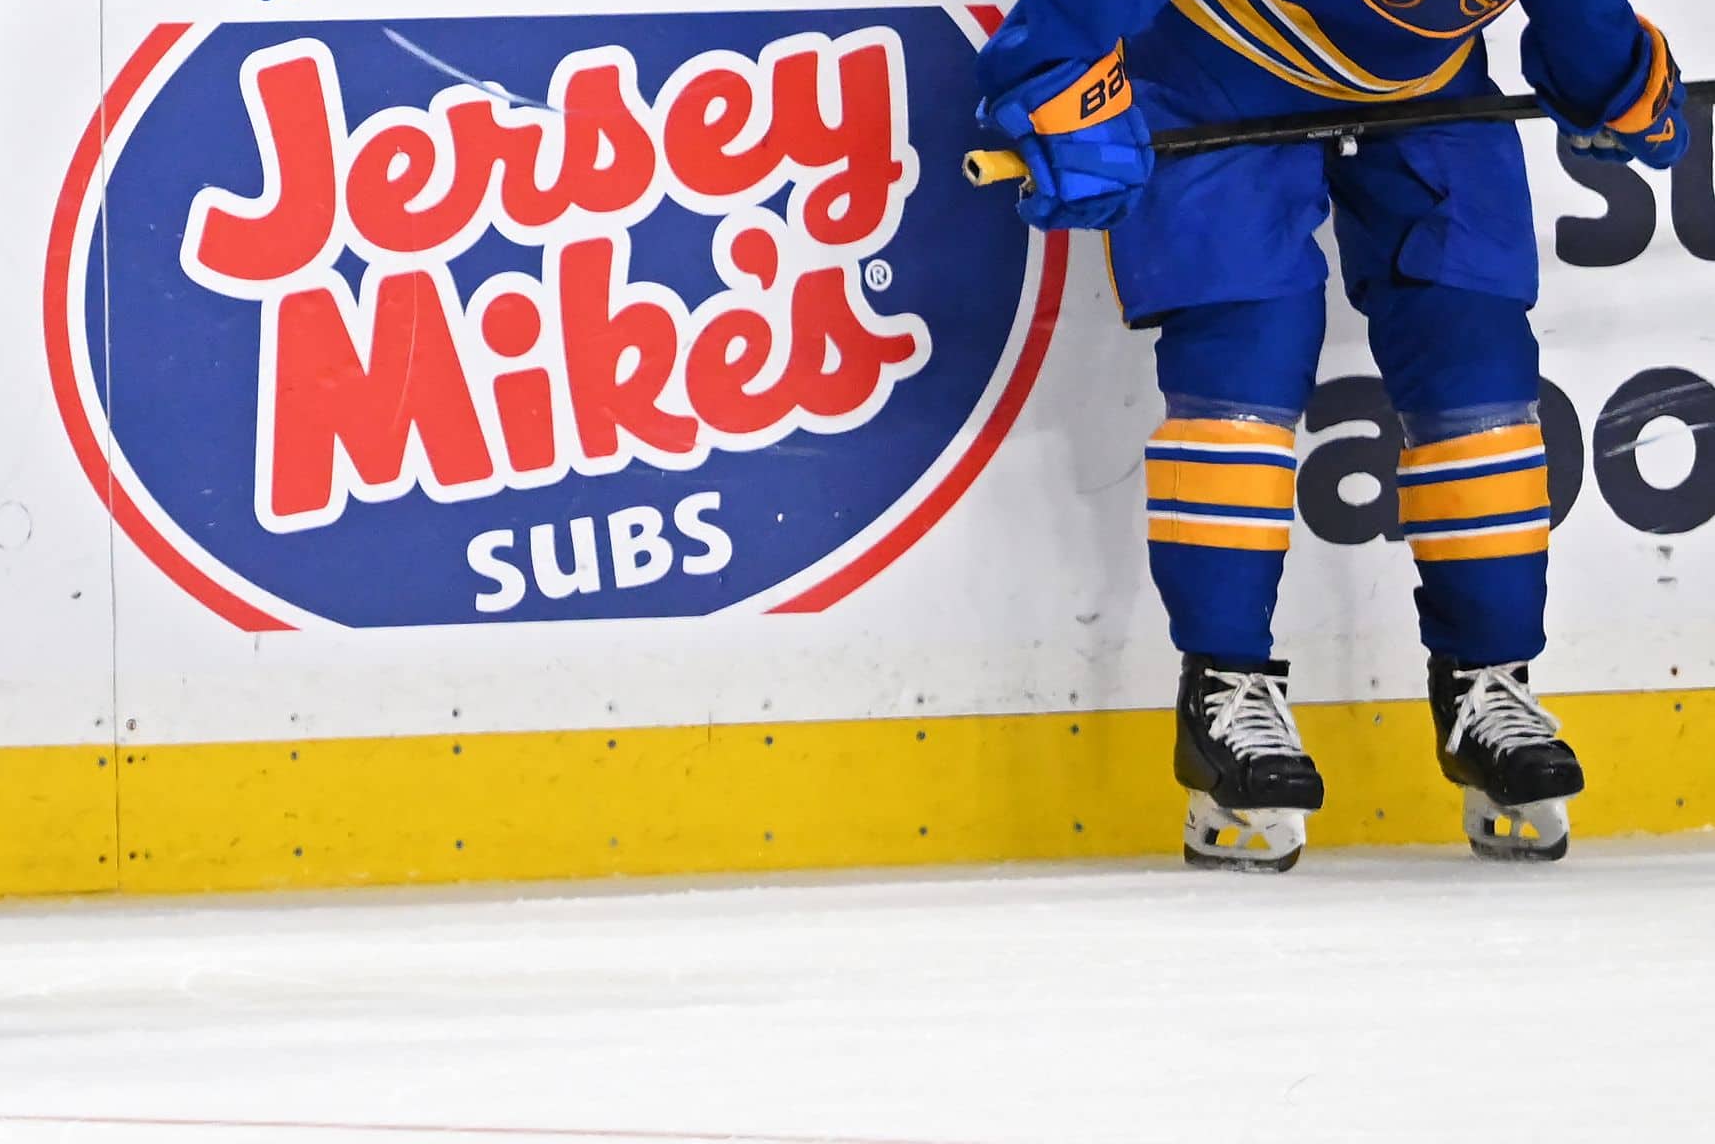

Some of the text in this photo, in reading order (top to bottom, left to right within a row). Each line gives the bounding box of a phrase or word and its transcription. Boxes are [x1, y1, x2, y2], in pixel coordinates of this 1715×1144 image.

[195, 42, 906, 283] Jersey
[270, 235, 917, 518] Mike's
[466, 491, 733, 613] SUBS
